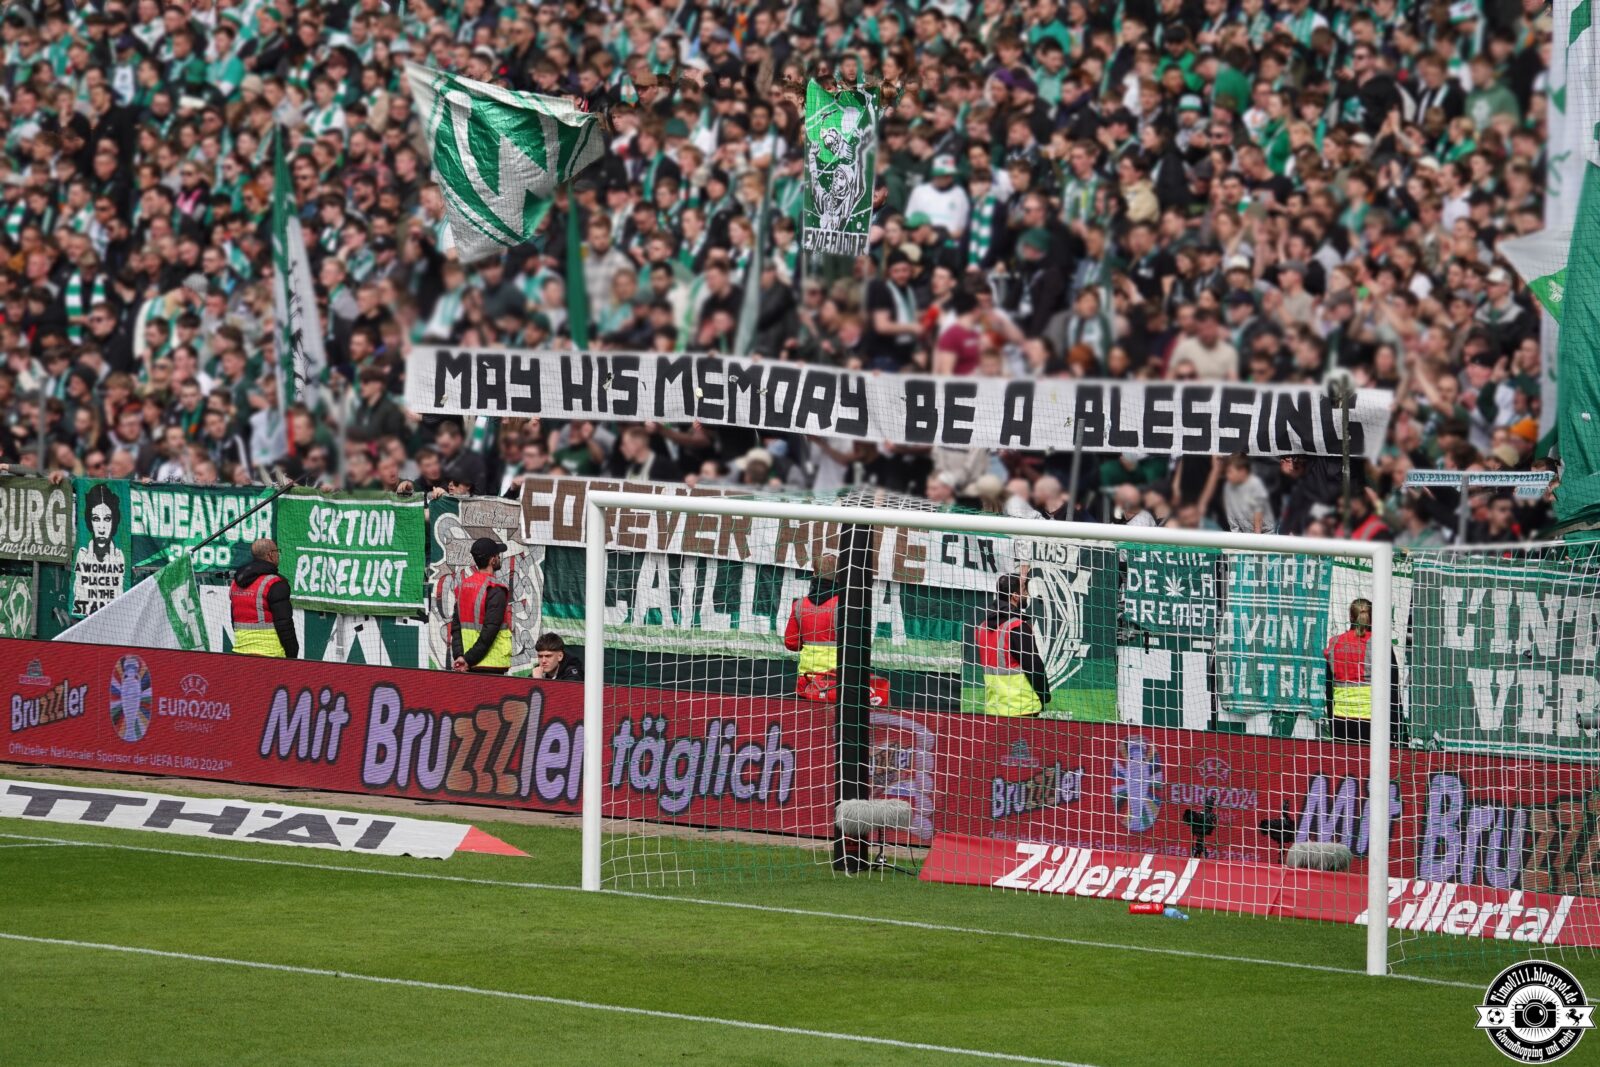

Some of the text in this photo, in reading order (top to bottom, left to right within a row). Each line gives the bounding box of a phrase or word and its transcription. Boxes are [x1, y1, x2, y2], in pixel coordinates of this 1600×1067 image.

[434, 350, 1365, 454] MAY HIS MEMORY BE A BLESSING
[1428, 473, 1476, 482] PARLIAO
[130, 490, 273, 543] ENDEAVOUR
[308, 504, 396, 547] SEKTION
[81, 576, 119, 586] PLACE IS
[88, 589, 114, 598] IN THE
[294, 555, 408, 599] REISELUST
[1127, 568, 1213, 597] DE LA
[180, 675, 209, 692] UEFA
[1220, 661, 1325, 700] ULTRAS
[11, 679, 88, 732] Bruzzzler
[261, 688, 349, 761] Mit
[363, 685, 584, 799] Bruzzzler
[612, 715, 795, 813] täglich
[994, 842, 1200, 905] Zillertal
[1354, 877, 1575, 944] Zillertal
